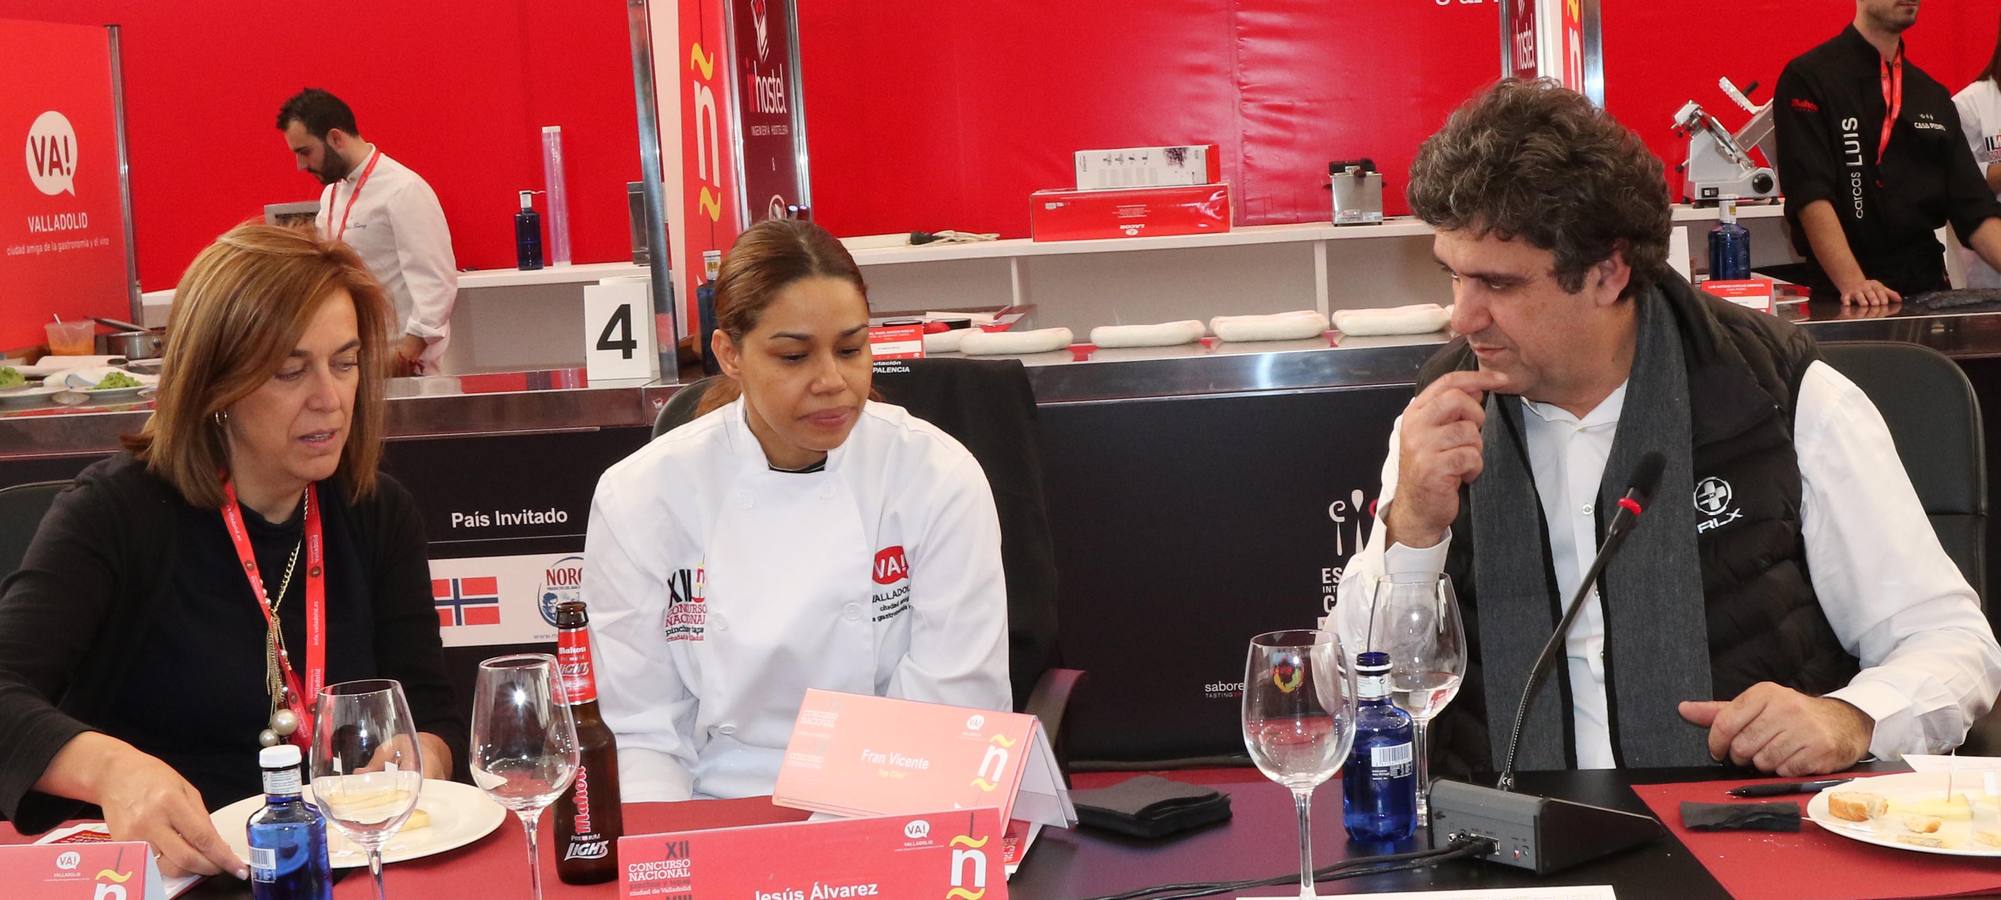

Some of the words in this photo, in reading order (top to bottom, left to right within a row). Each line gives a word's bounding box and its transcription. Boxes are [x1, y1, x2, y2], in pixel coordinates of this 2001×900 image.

[1842, 117, 1864, 166] LUIS
[30, 135, 71, 177] VA!
[1851, 171, 1864, 219] carcas
[28, 212, 88, 233] VALLADOLID
[596, 304, 637, 359] 4
[872, 366, 911, 374] PALENCIA
[451, 511, 491, 528] País
[495, 508, 568, 526] Invitado
[875, 554, 906, 578] VA!
[1323, 586, 1337, 594] INT
[861, 749, 887, 765] Fran
[889, 754, 929, 770] Vicente
[572, 766, 591, 834] Mahou
[907, 825, 926, 835] VA!
[564, 840, 609, 861] LIGHT
[666, 841, 689, 859] XII
[60, 856, 76, 866] VA!
[628, 859, 691, 872] CONCURSO
[628, 868, 691, 882] NACIONAL
[755, 888, 805, 900] Jesús
[810, 881, 878, 900] Álvarez
